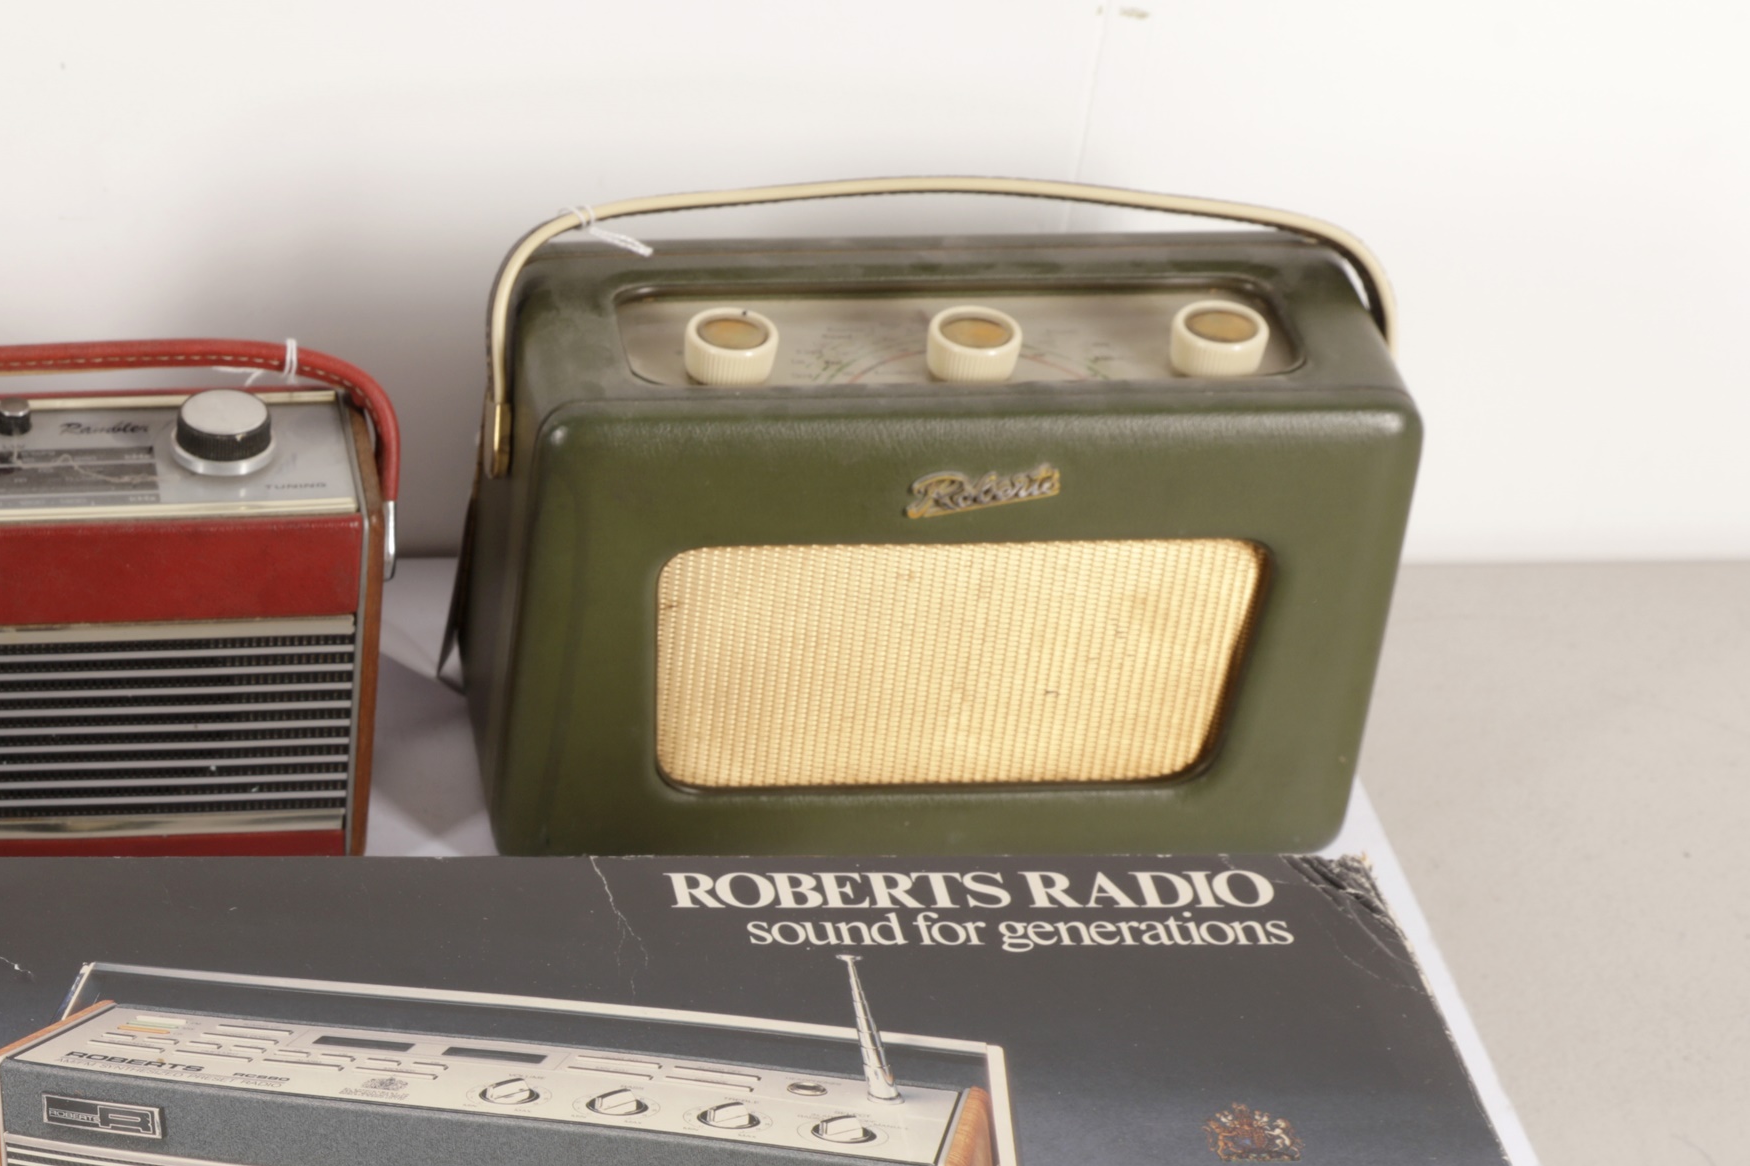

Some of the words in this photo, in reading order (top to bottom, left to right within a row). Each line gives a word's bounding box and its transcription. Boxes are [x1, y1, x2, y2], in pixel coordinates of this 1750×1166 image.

[59, 421, 149, 436] Rambler
[265, 481, 327, 490] TUNING
[663, 871, 1012, 909] ROBERTS
[1018, 870, 1275, 909] RADIO
[747, 911, 910, 946] sound
[913, 911, 986, 946] for
[998, 911, 1295, 953] generations
[65, 1051, 205, 1072] ROBERTS
[232, 1072, 290, 1082] RCS80
[240, 1079, 282, 1088] RADIO
[48, 1109, 100, 1123] ROBERTS
